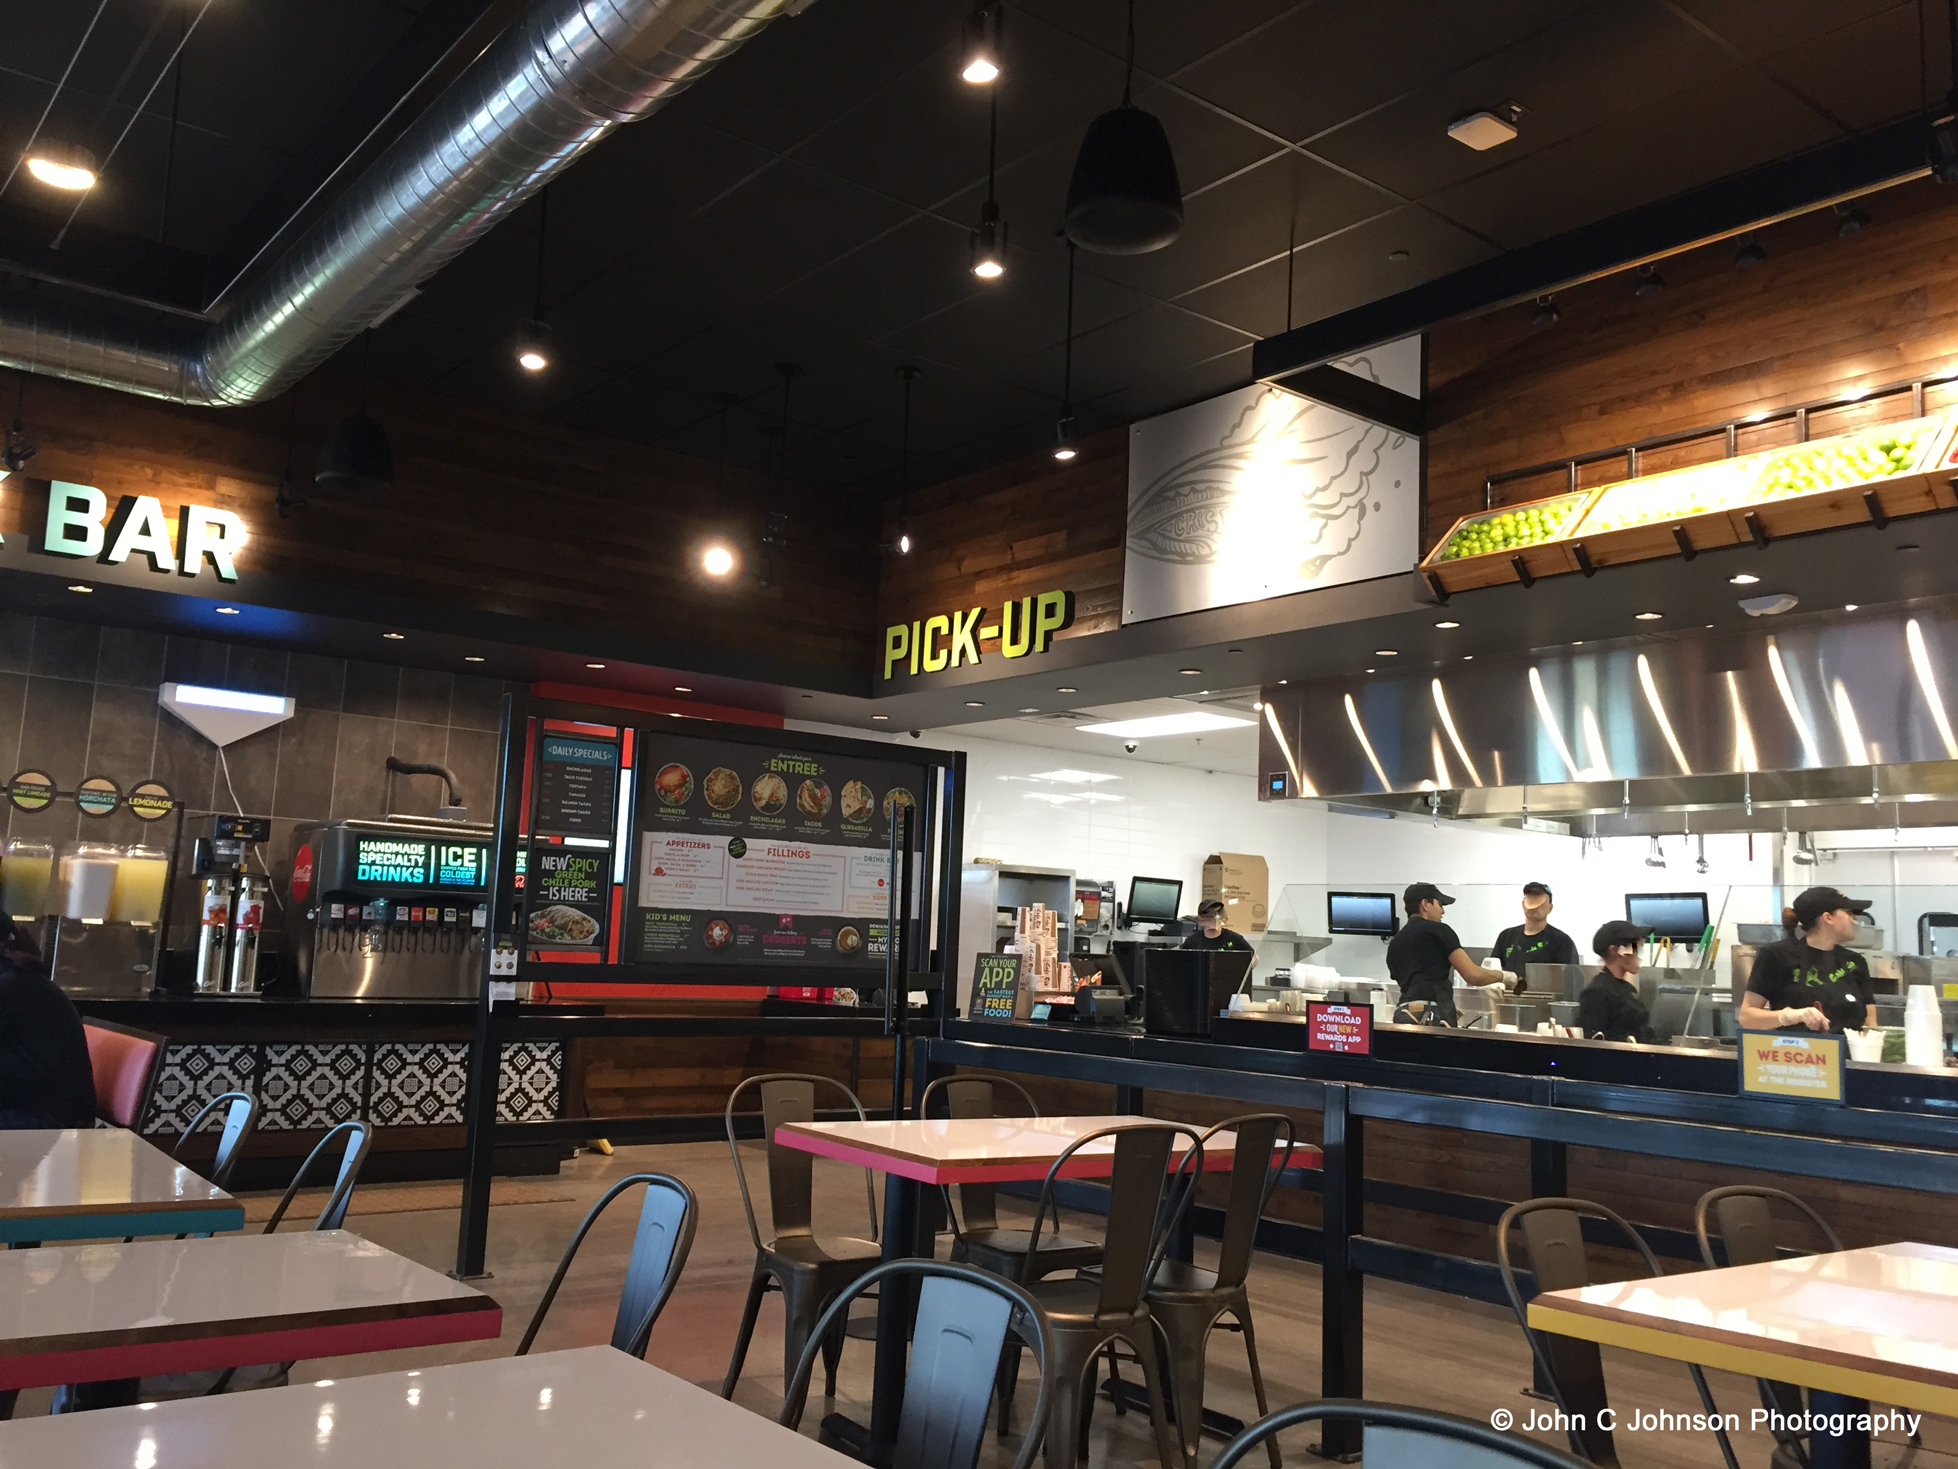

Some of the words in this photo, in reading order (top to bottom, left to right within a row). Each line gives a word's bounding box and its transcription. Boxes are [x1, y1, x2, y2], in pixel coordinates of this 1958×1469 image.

[44, 480, 248, 581] BAR
[884, 589, 1066, 680] PICK-UP
[552, 746, 574, 756] DAILY
[574, 748, 608, 760] SPECIALS
[770, 758, 818, 776] ENTREE
[79, 794, 116, 804] HORCHATA
[128, 797, 173, 808] LEMONADE
[660, 807, 686, 815] BURRITO
[750, 815, 786, 824] ENCHILADAS
[360, 841, 425, 854] HANDMADE
[666, 840, 711, 850] APPETIZERS
[359, 852, 425, 866] SPECIALTY
[441, 846, 477, 867] ICE
[767, 848, 811, 859] FILLINGS
[541, 854, 572, 870] NEW
[569, 858, 600, 872] SPICY
[358, 865, 424, 883] DRINKS
[440, 870, 476, 879] COLDEST
[555, 870, 585, 879] GREEN
[542, 878, 569, 887] CHILE
[571, 880, 596, 888] PORK
[549, 887, 560, 900] IS
[561, 887, 588, 901] HERE
[646, 913, 667, 921] KID'S
[762, 934, 807, 945] DESSERTS
[981, 958, 998, 967] SCAN
[999, 958, 1017, 968] YOUR
[979, 967, 1014, 988] APP
[985, 998, 1013, 1009] FREE
[984, 1008, 1012, 1018] FOOD!
[1317, 1014, 1361, 1024] DOWNLOAD
[1326, 1024, 1339, 1034] OUR
[1338, 1025, 1352, 1033] NEW
[1317, 1032, 1347, 1042] REWARDS
[1757, 1049, 1779, 1062] WE
[1784, 1051, 1826, 1065] SCAN
[1766, 1064, 1787, 1074] YOUR
